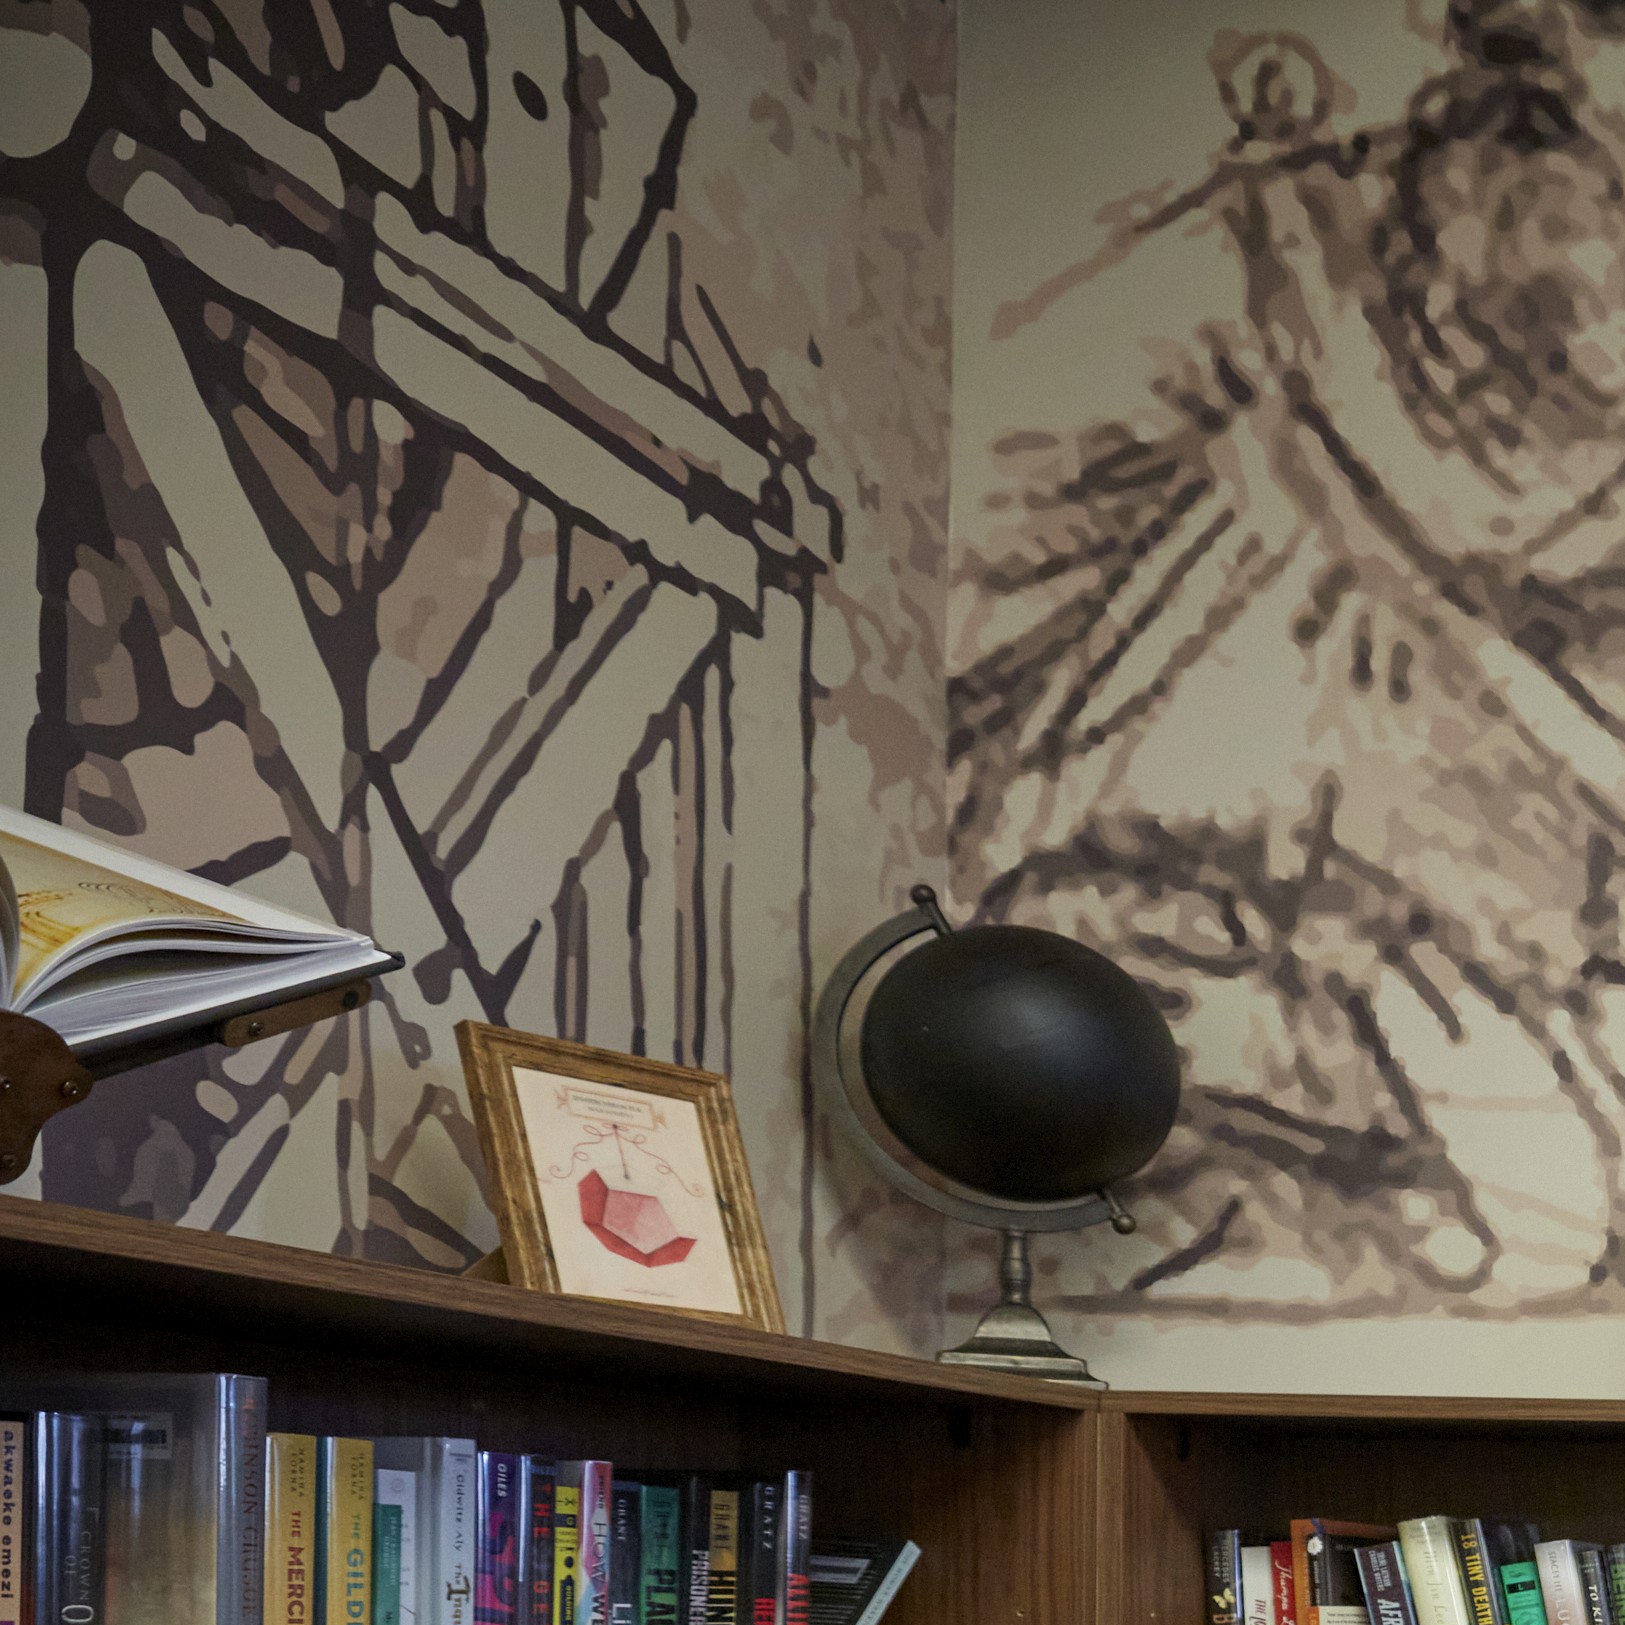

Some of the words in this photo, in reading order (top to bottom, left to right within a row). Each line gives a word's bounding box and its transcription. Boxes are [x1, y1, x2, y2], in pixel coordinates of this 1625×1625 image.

[291, 1511, 302, 1538] THE
[353, 1514, 361, 1540] THE
[762, 1487, 774, 1549] GRATZ
[1461, 1533, 1476, 1549] 18
[79, 1531, 93, 1600] CROWN
[1465, 1554, 1483, 1581] TINY
[1275, 1560, 1293, 1609] Jhumpa
[1589, 1585, 1597, 1600] TO
